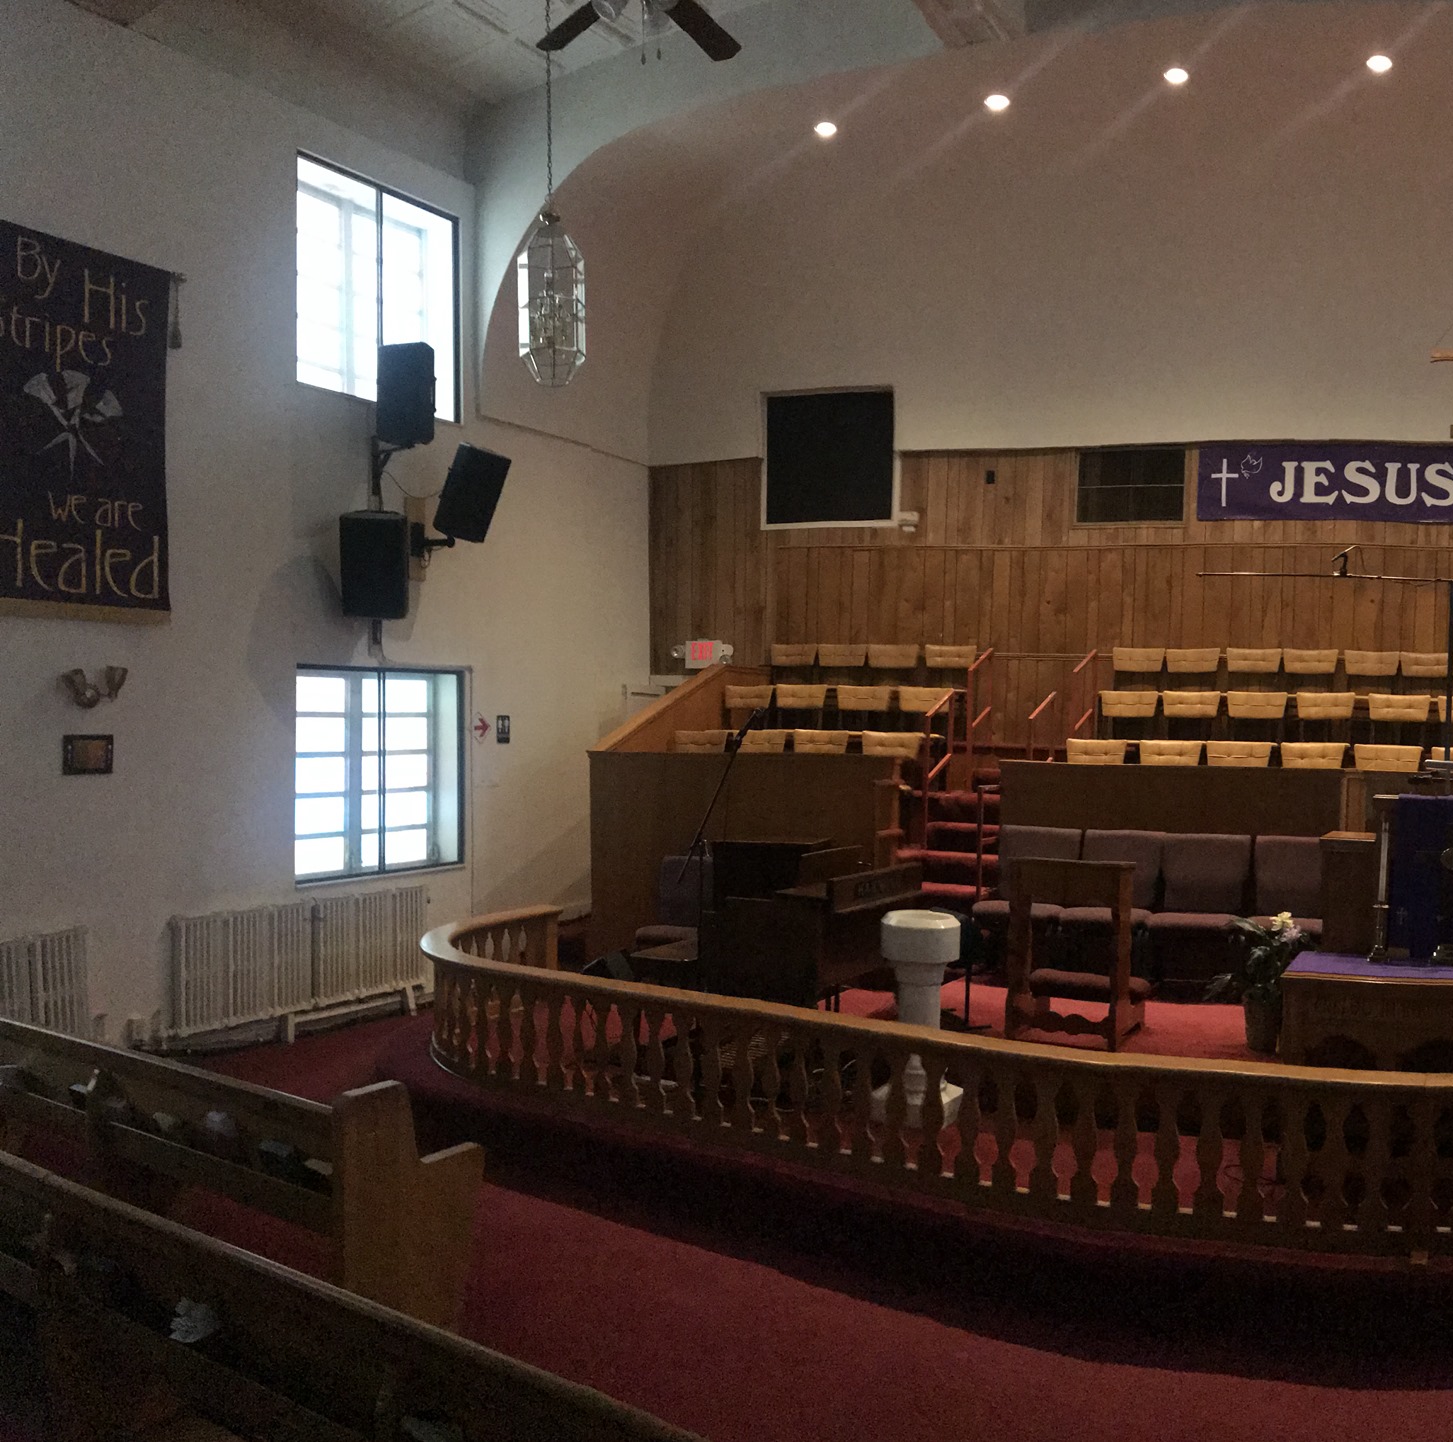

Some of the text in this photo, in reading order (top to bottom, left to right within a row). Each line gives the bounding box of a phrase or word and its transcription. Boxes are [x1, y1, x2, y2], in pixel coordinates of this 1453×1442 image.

[17, 235, 149, 335] By His
[0, 300, 114, 372] tripes
[47, 490, 143, 531] we are
[691, 641, 714, 661] EXIT
